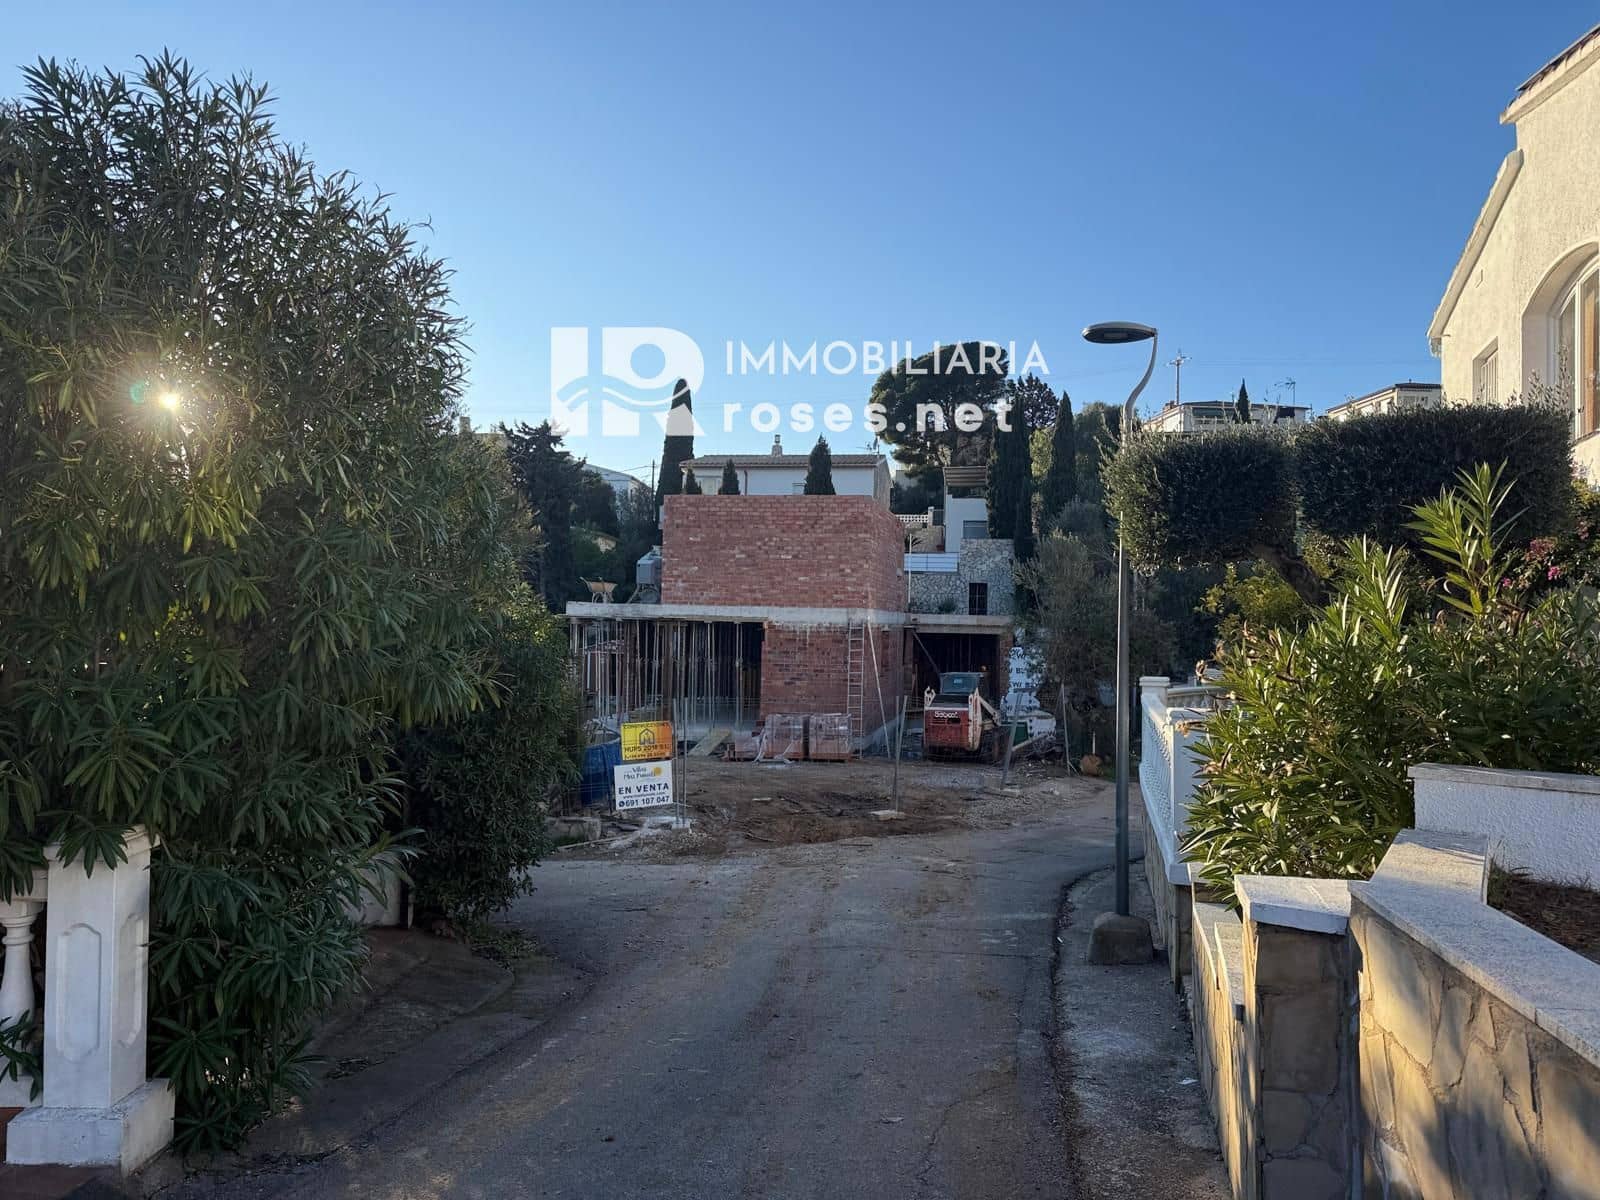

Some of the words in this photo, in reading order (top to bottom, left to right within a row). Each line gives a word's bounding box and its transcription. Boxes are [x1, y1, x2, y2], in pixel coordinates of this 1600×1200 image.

[618, 786, 632, 795] EN
[636, 783, 669, 792] VENTA
[625, 799, 639, 807] 691
[642, 797, 655, 805] 107
[656, 795, 670, 803] 047
